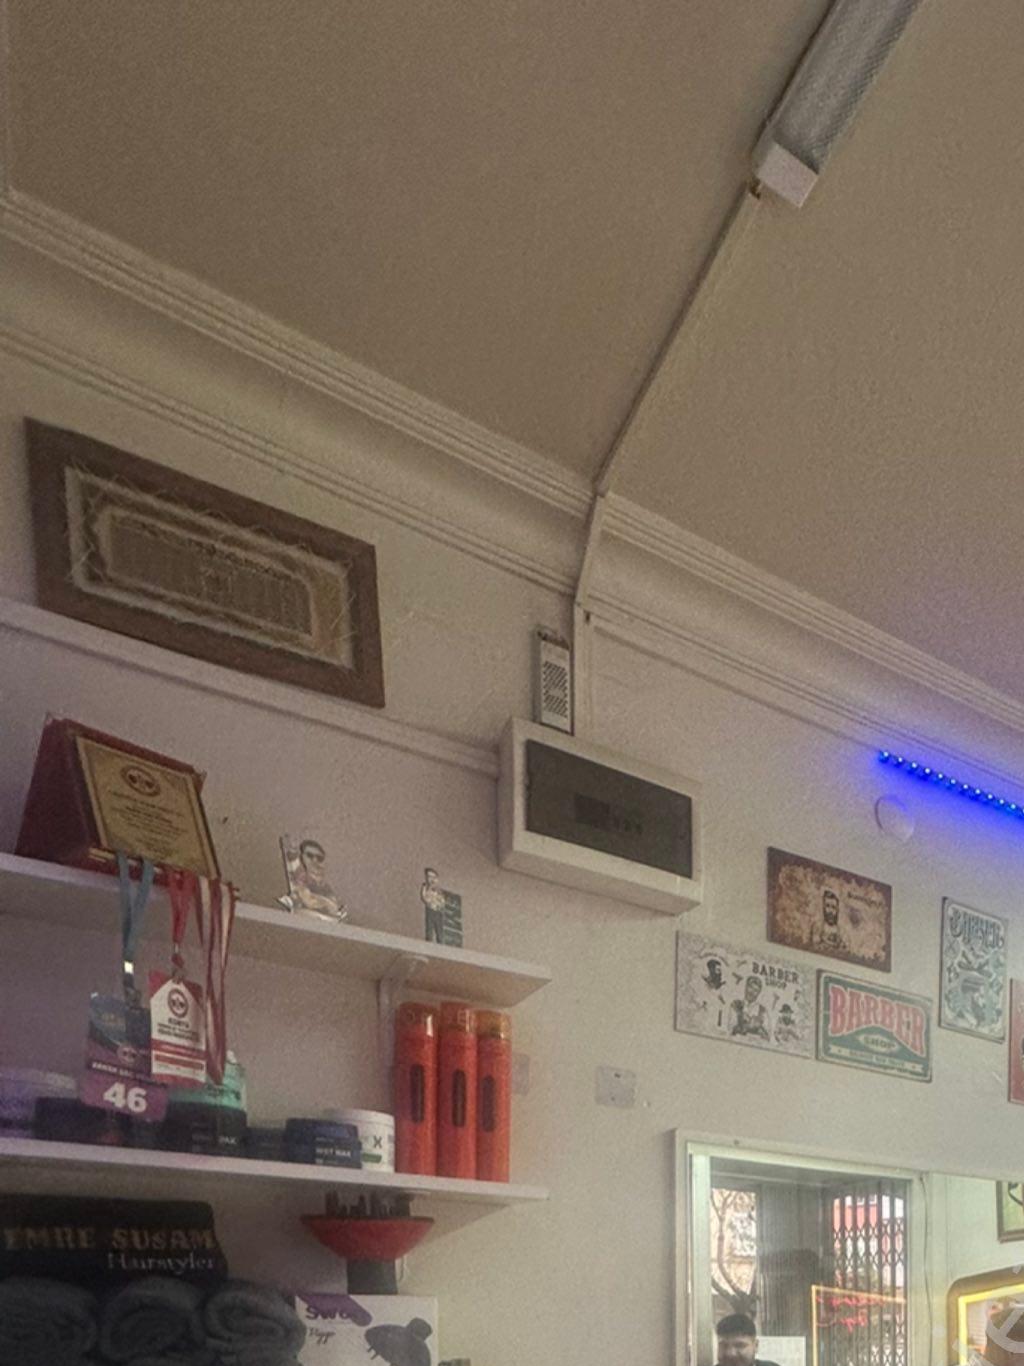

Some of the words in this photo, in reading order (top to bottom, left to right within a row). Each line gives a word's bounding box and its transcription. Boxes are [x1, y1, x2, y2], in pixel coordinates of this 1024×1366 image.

[752, 961, 799, 984] BARBER
[829, 985, 926, 1057] BARBER
[103, 1082, 147, 1112] 46
[111, 1228, 216, 1250] SUSAM
